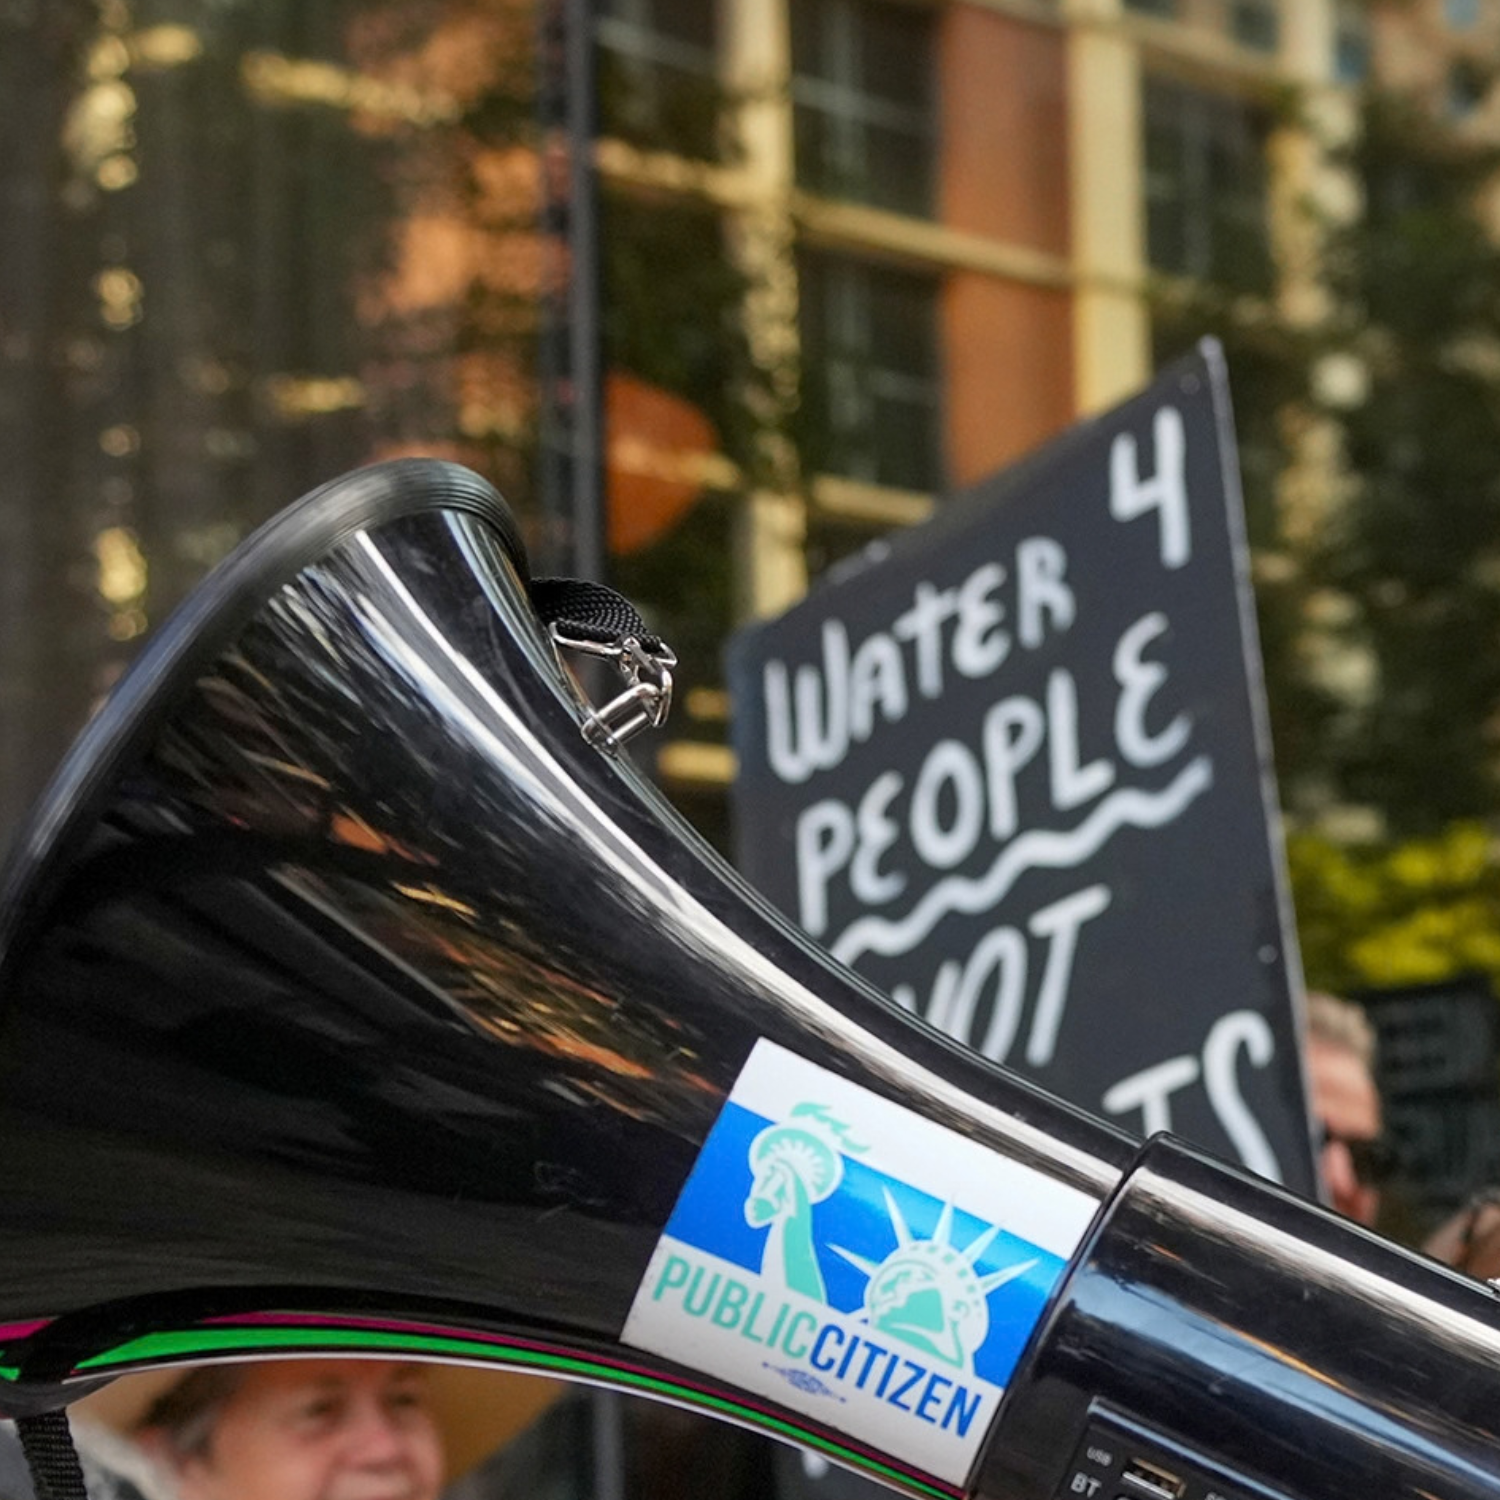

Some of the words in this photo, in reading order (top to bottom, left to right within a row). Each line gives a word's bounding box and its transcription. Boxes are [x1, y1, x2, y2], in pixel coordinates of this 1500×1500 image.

[763, 535, 1076, 784] WATER
[1108, 404, 1191, 570] 4
[796, 611, 1194, 937] PEOPLE
[1070, 1472, 1102, 1499] BT
